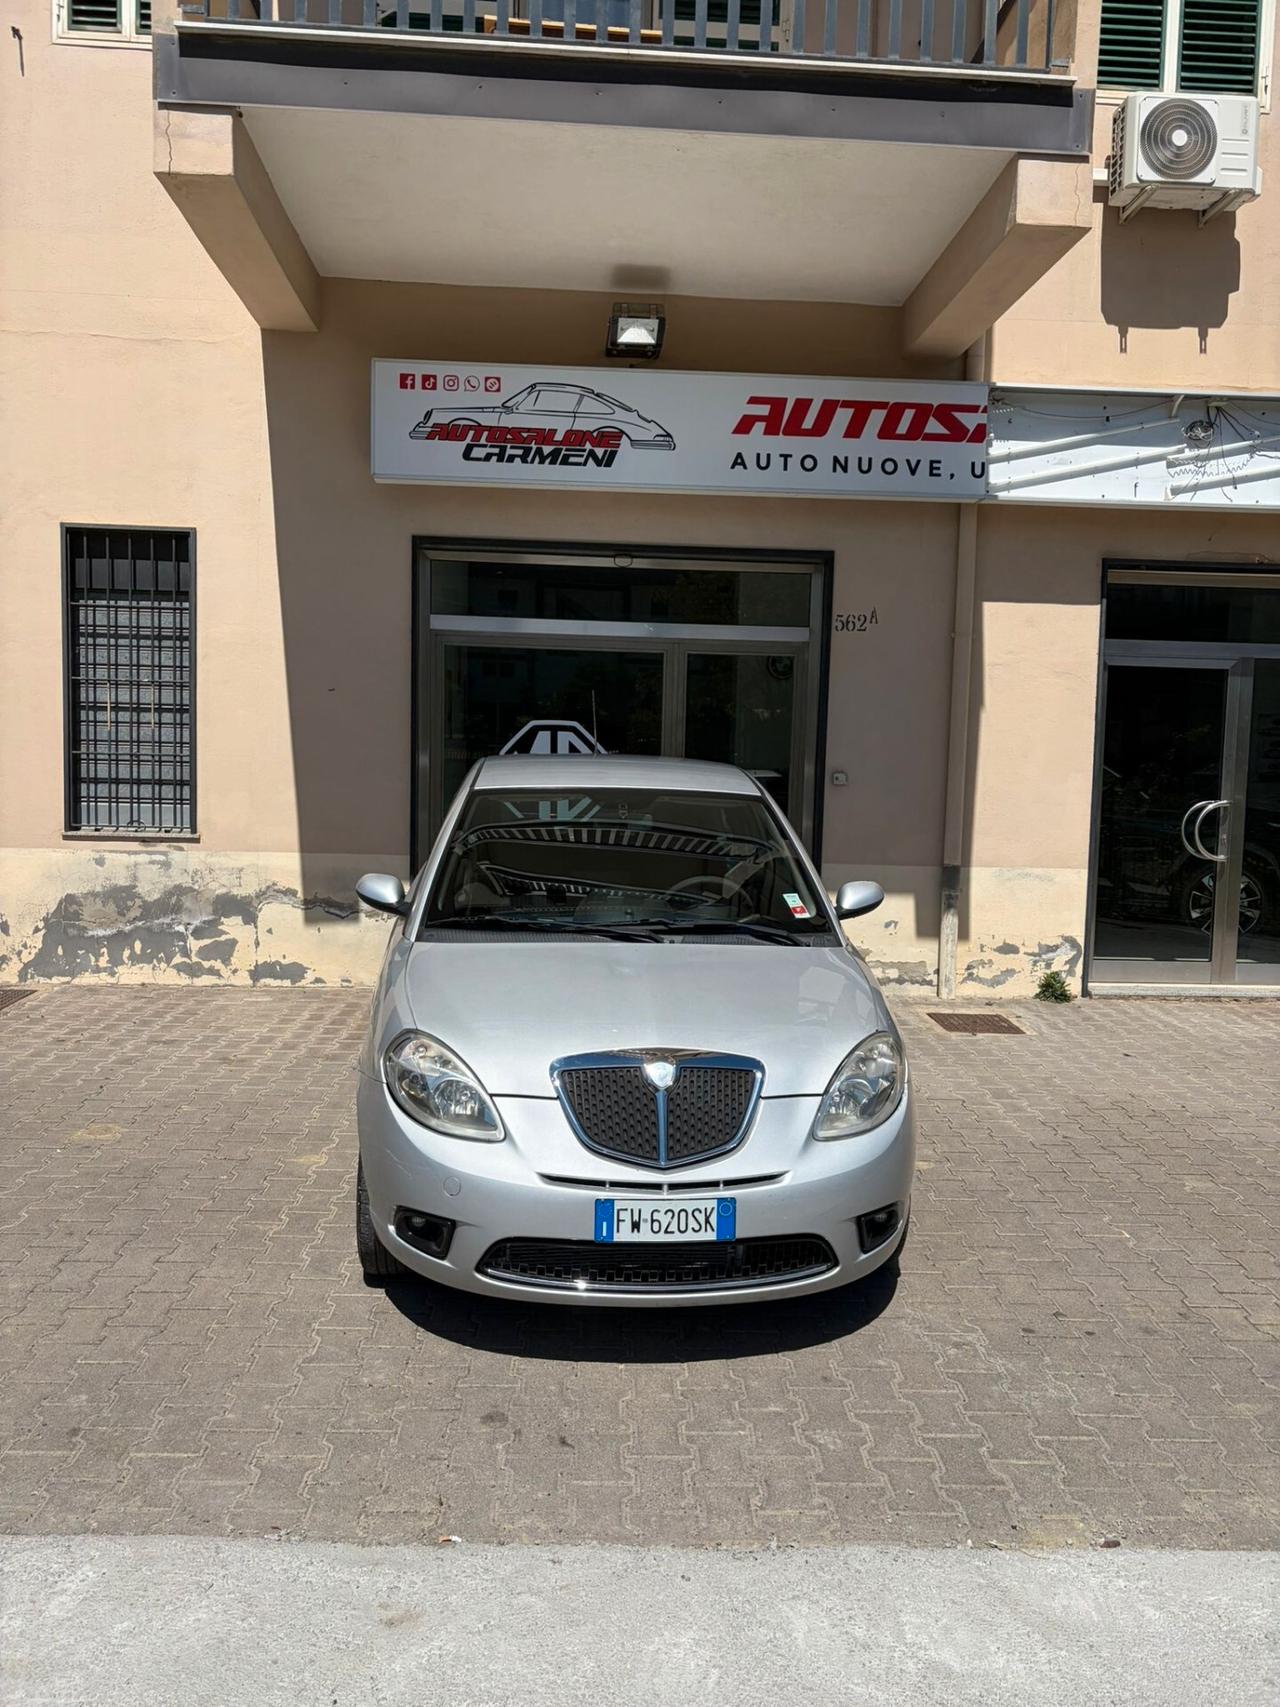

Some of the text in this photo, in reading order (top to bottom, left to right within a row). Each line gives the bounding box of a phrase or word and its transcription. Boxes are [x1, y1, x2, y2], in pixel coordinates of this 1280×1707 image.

[425, 422, 623, 449] AUTOSALONE
[462, 443, 618, 468] CARMENI
[730, 452, 818, 473] AUTO
[832, 455, 956, 480] NUOVE,
